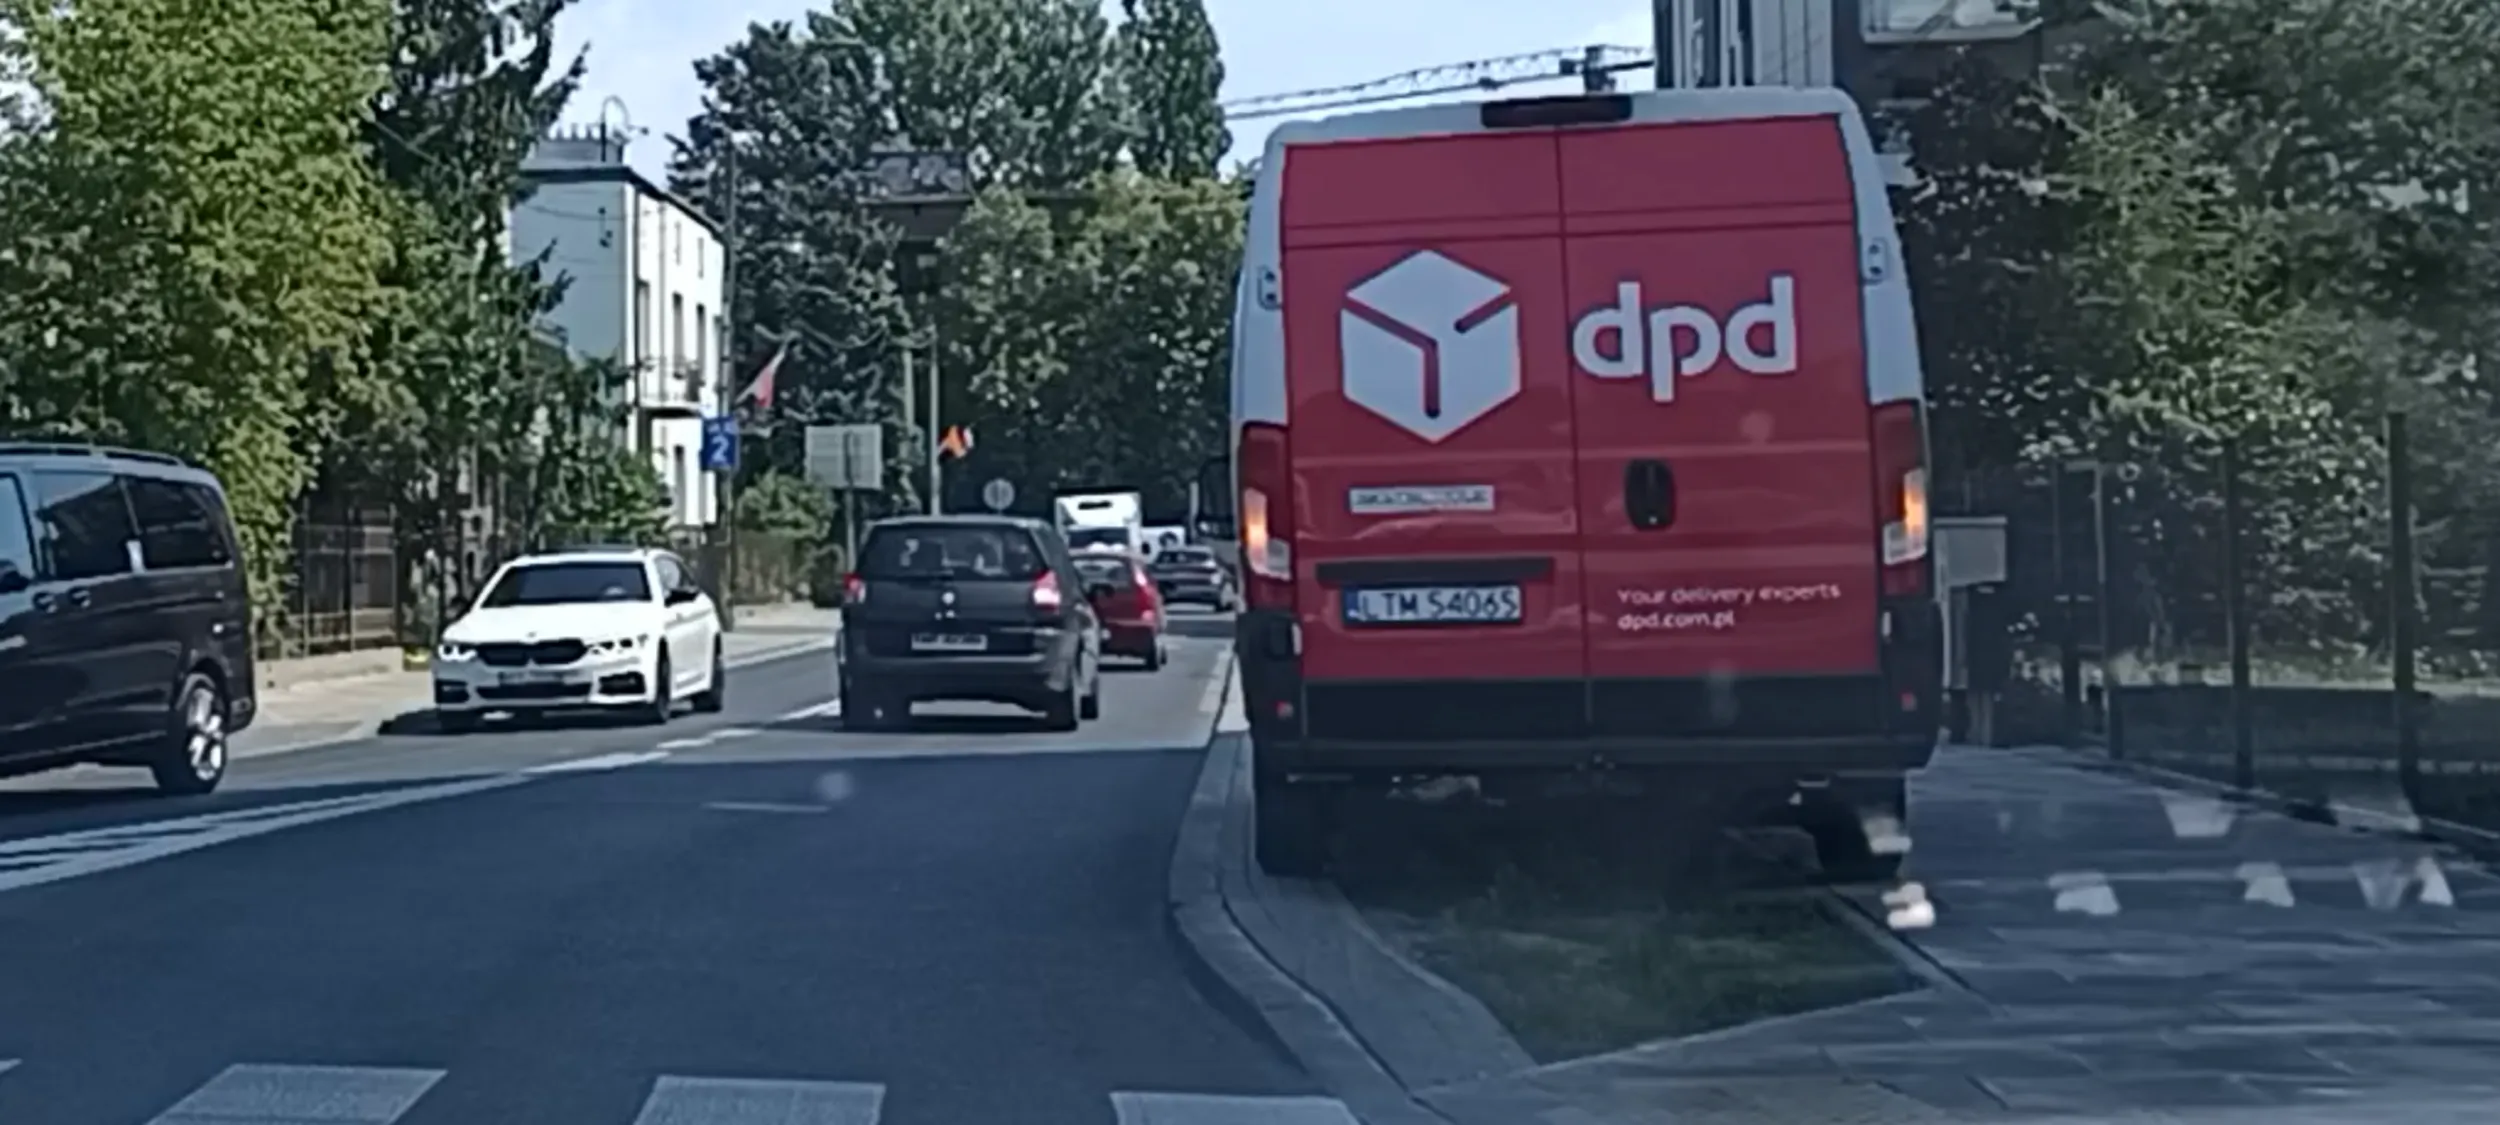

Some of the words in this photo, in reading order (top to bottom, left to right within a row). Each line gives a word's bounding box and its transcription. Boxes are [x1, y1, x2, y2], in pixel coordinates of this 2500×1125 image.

[1573, 275, 1797, 402] dpd
[711, 436, 729, 461] 2
[1362, 591, 1418, 621] LTM
[1617, 589, 1666, 604] Your
[1671, 587, 1755, 606] delivery
[1758, 584, 1842, 602] experts
[1617, 610, 1736, 631] dpd.com.pl
